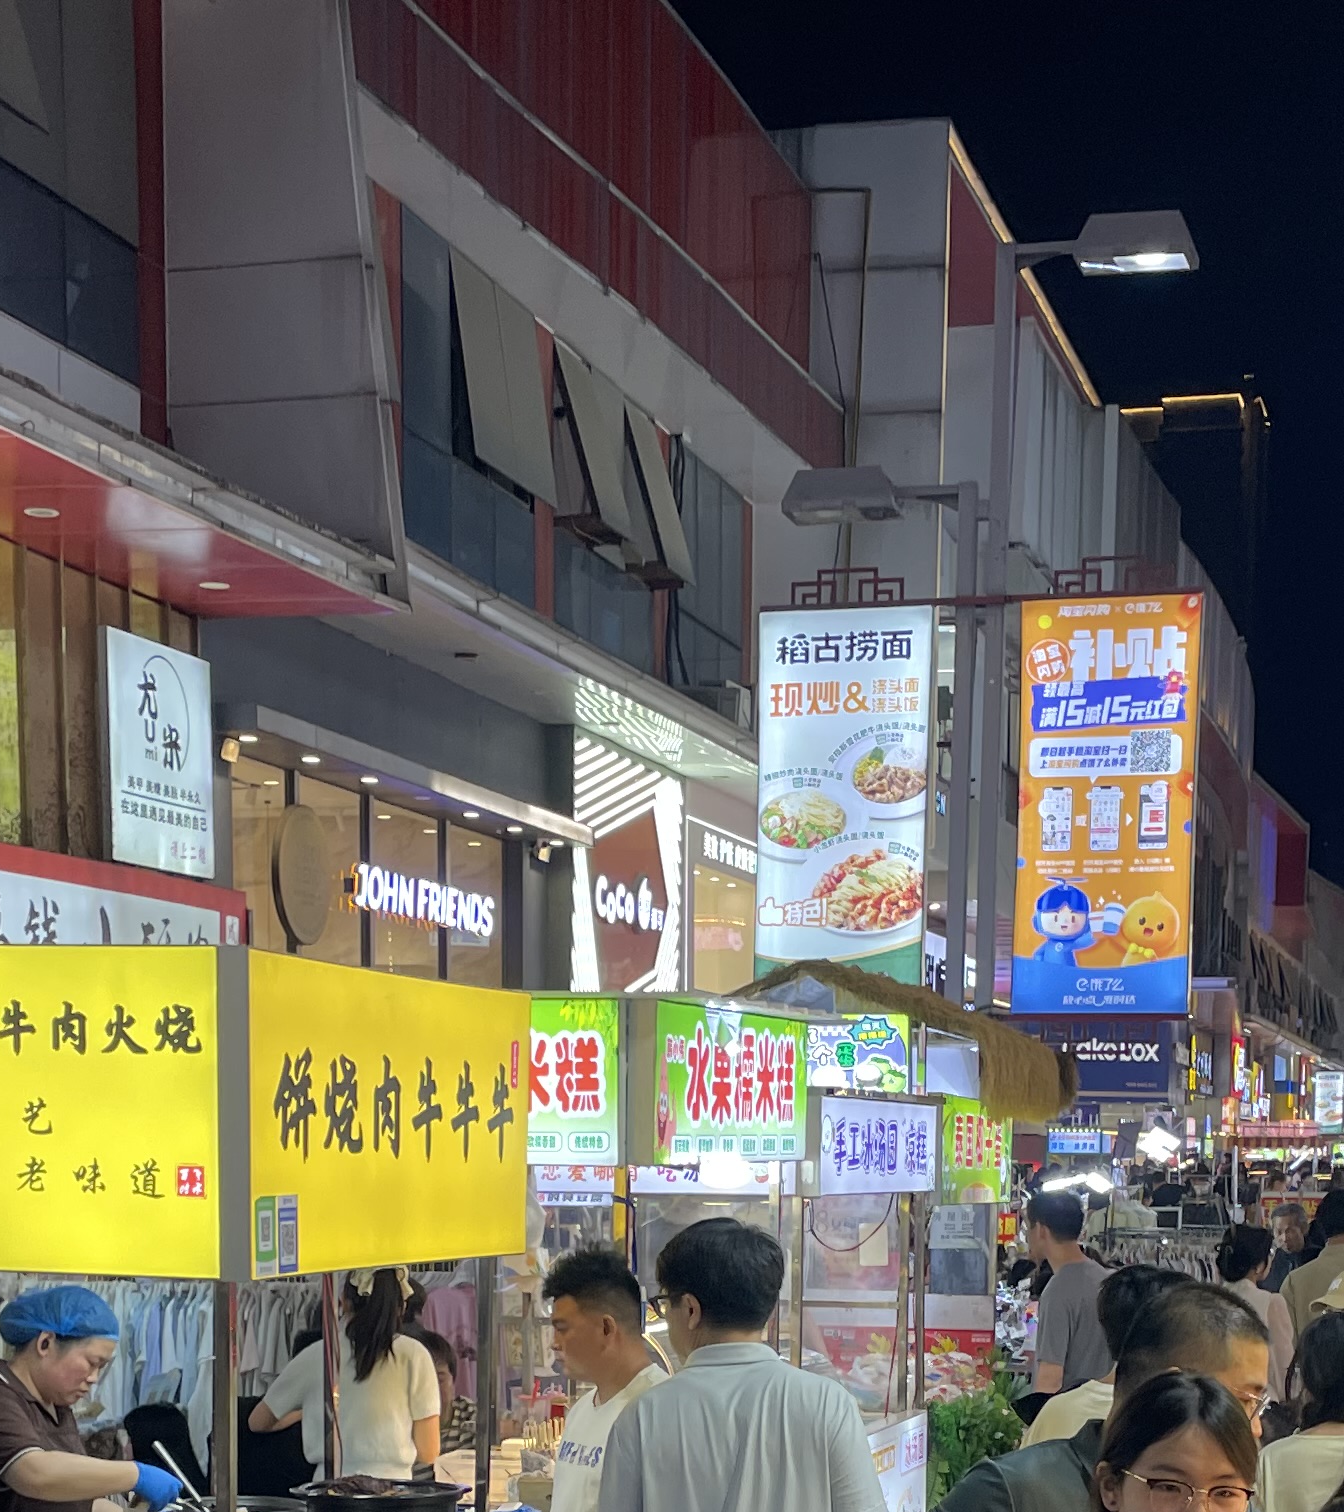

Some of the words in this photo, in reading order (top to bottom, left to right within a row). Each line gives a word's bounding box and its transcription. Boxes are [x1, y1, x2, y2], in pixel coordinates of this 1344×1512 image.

[775, 629, 914, 666] 稻古捞面
[1069, 626, 1188, 681] 补贴
[1039, 696, 1181, 728] 满15减15元红包
[120, 797, 208, 833] 在这里遇见最美的自己
[357, 864, 415, 917] JOHN
[416, 877, 496, 937] FRIENDS
[685, 1026, 796, 1125] 水果糯米糕
[17, 1155, 166, 1200] 老味道
